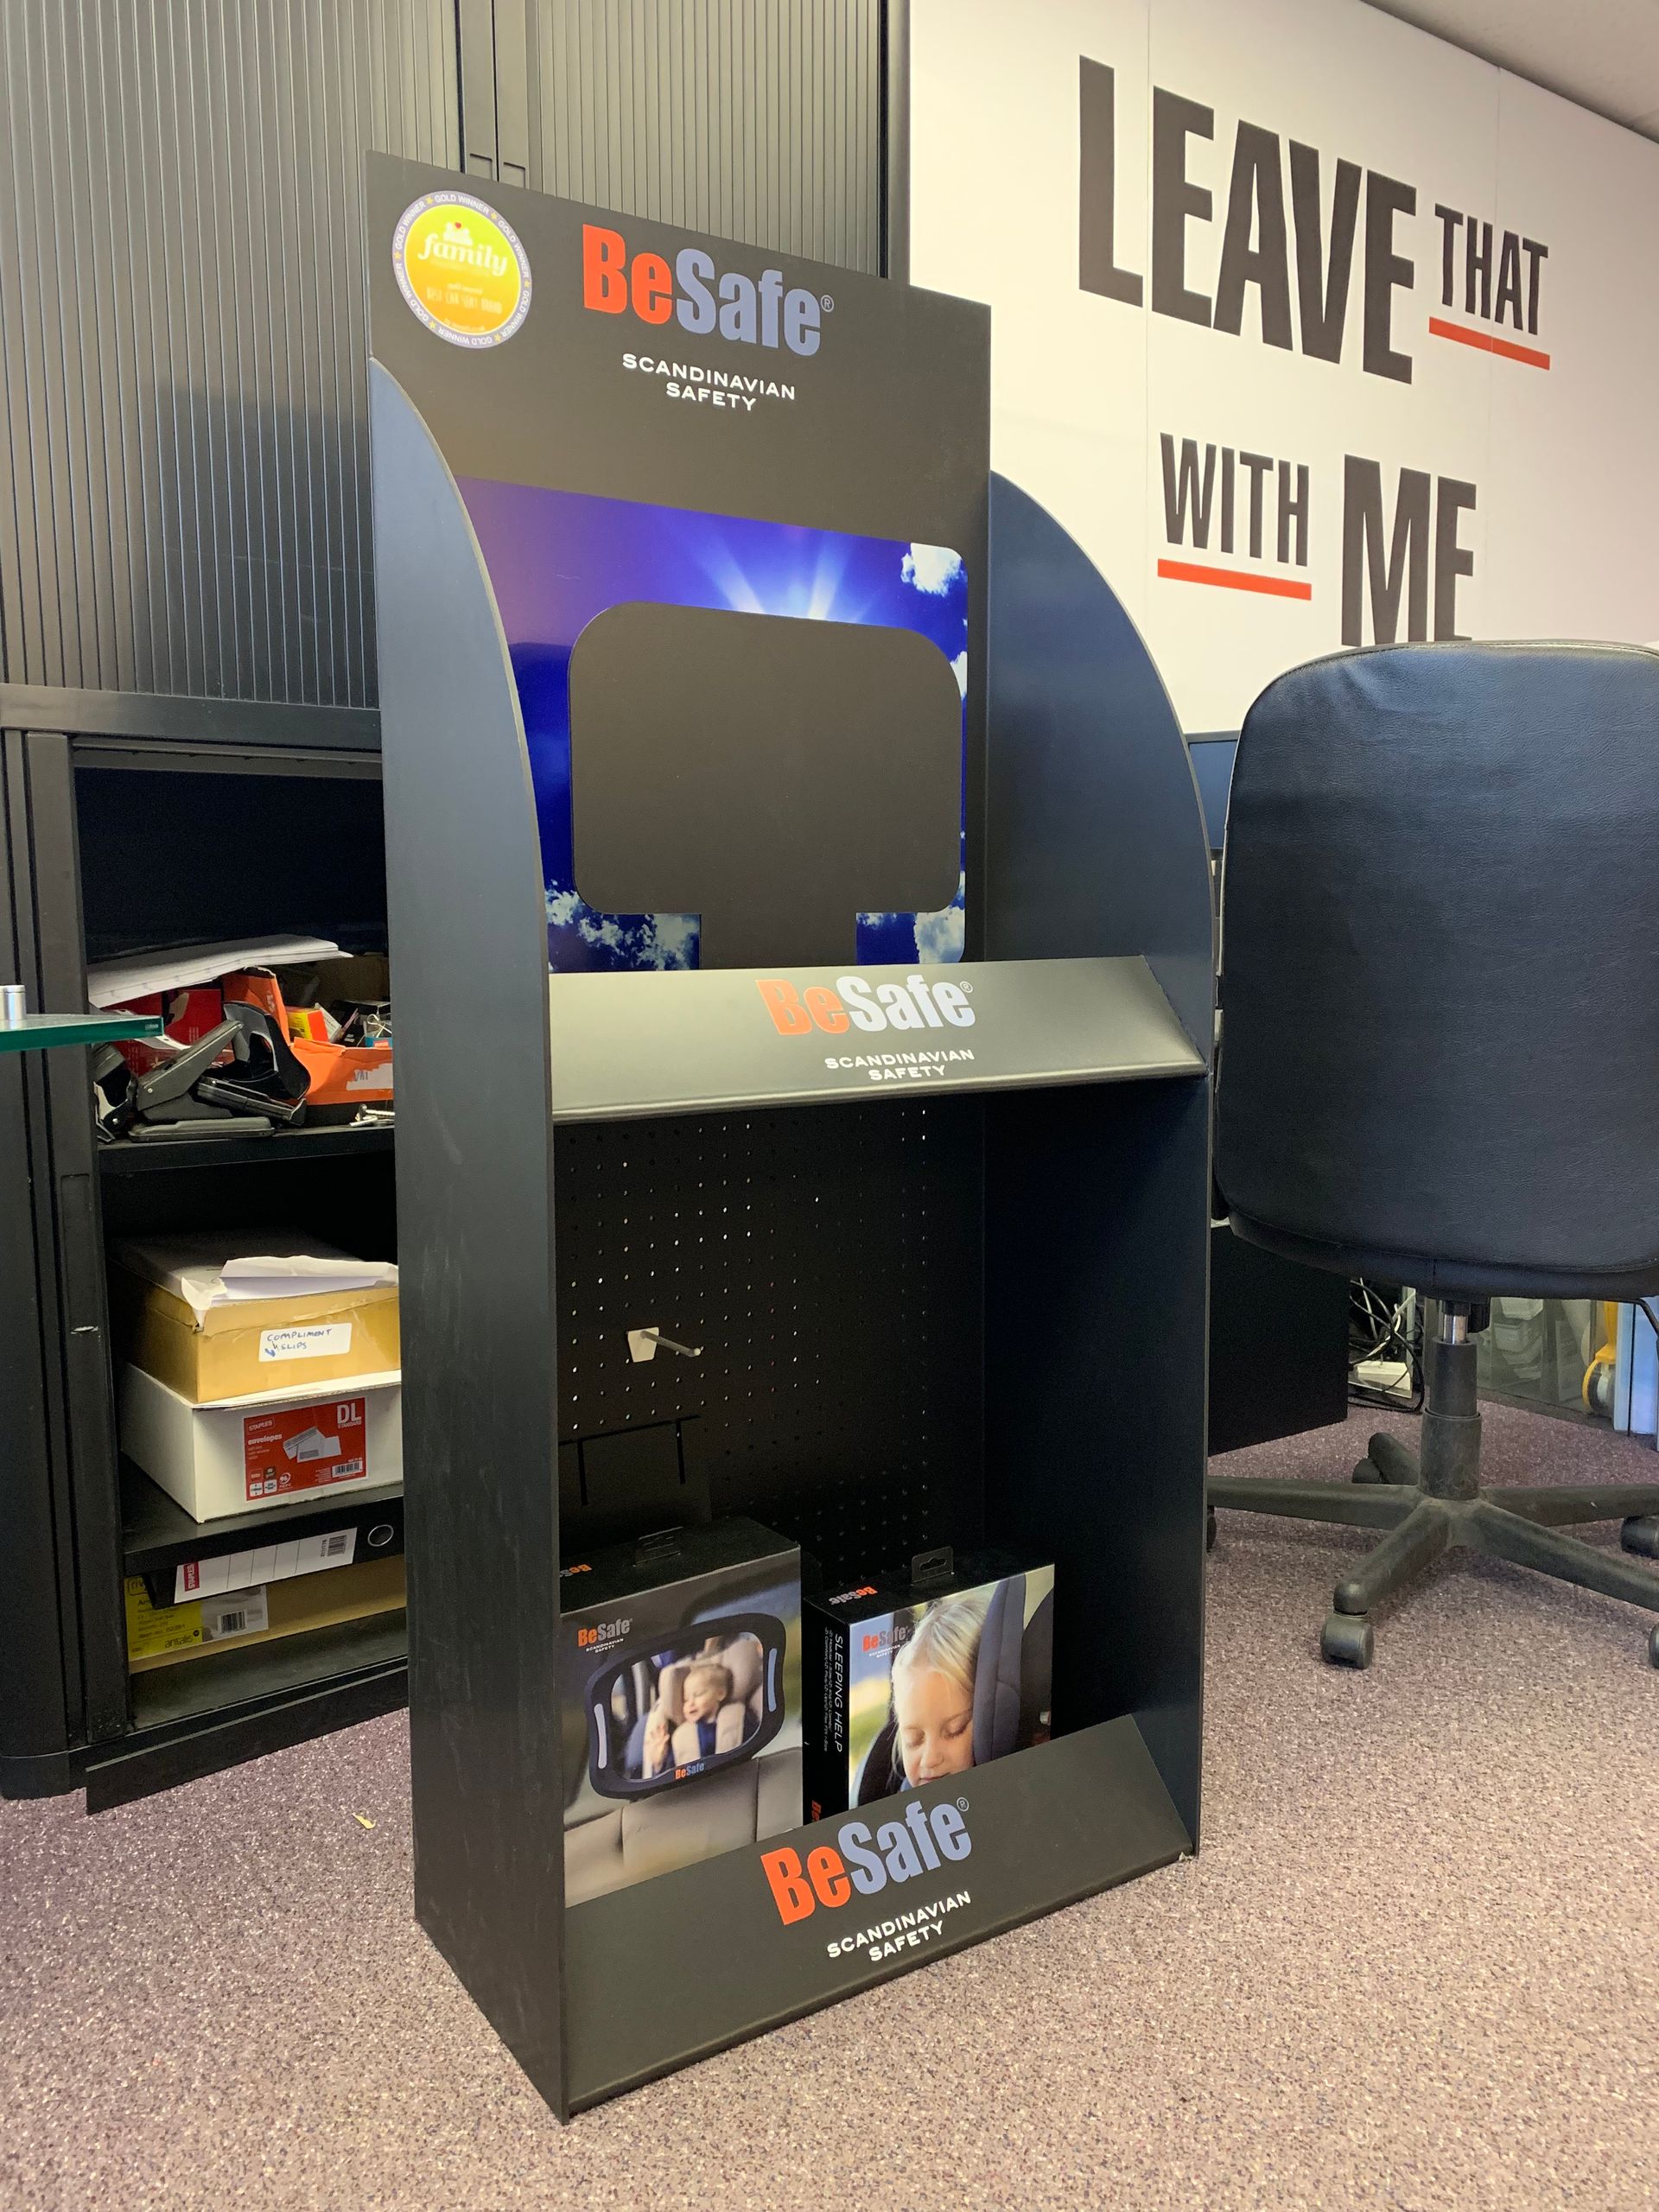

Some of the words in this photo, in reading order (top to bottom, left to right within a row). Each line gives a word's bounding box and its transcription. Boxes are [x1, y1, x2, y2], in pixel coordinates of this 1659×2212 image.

[435, 194, 456, 203] GOLD
[458, 195, 490, 215] WINNER
[395, 226, 406, 250] GOLD
[404, 200, 427, 226] WINNER
[1079, 54, 1417, 385] LEAVE
[1434, 202, 1549, 336] THAT
[417, 232, 508, 276] family
[498, 220, 516, 243] GOLD
[514, 242, 530, 278] WINNER
[395, 262, 413, 299] WINNER
[411, 299, 429, 321] GOLD
[519, 290, 530, 312] GOLD
[438, 326, 470, 345] WINNER
[500, 311, 524, 338] WINNER
[471, 335, 493, 346] GOLD
[622, 353, 795, 400] SCANDINAVIAN
[665, 382, 757, 411] SAFETY
[1160, 432, 1309, 567] WITH
[1341, 454, 1477, 646] ME
[824, 1049, 975, 1070] SCANDINAVIAN
[868, 1065, 946, 1081] SAFETY
[267, 1328, 333, 1342] COMPLIMENT
[281, 1341, 308, 1351] SLIPS
[337, 1402, 362, 1424] DL
[248, 1420, 273, 1431] STAPLES
[248, 1433, 283, 1446] envelopes
[164, 1634, 194, 1649] antalis
[586, 1638, 624, 1652] SCANDINAVIAN
[594, 1644, 616, 1654] SAFETY
[835, 1633, 843, 1708] SLEEPING
[835, 1712, 843, 1752] HELP
[827, 1891, 971, 1958] SCANDINAVIAN
[868, 1920, 944, 1961] SAFETY
